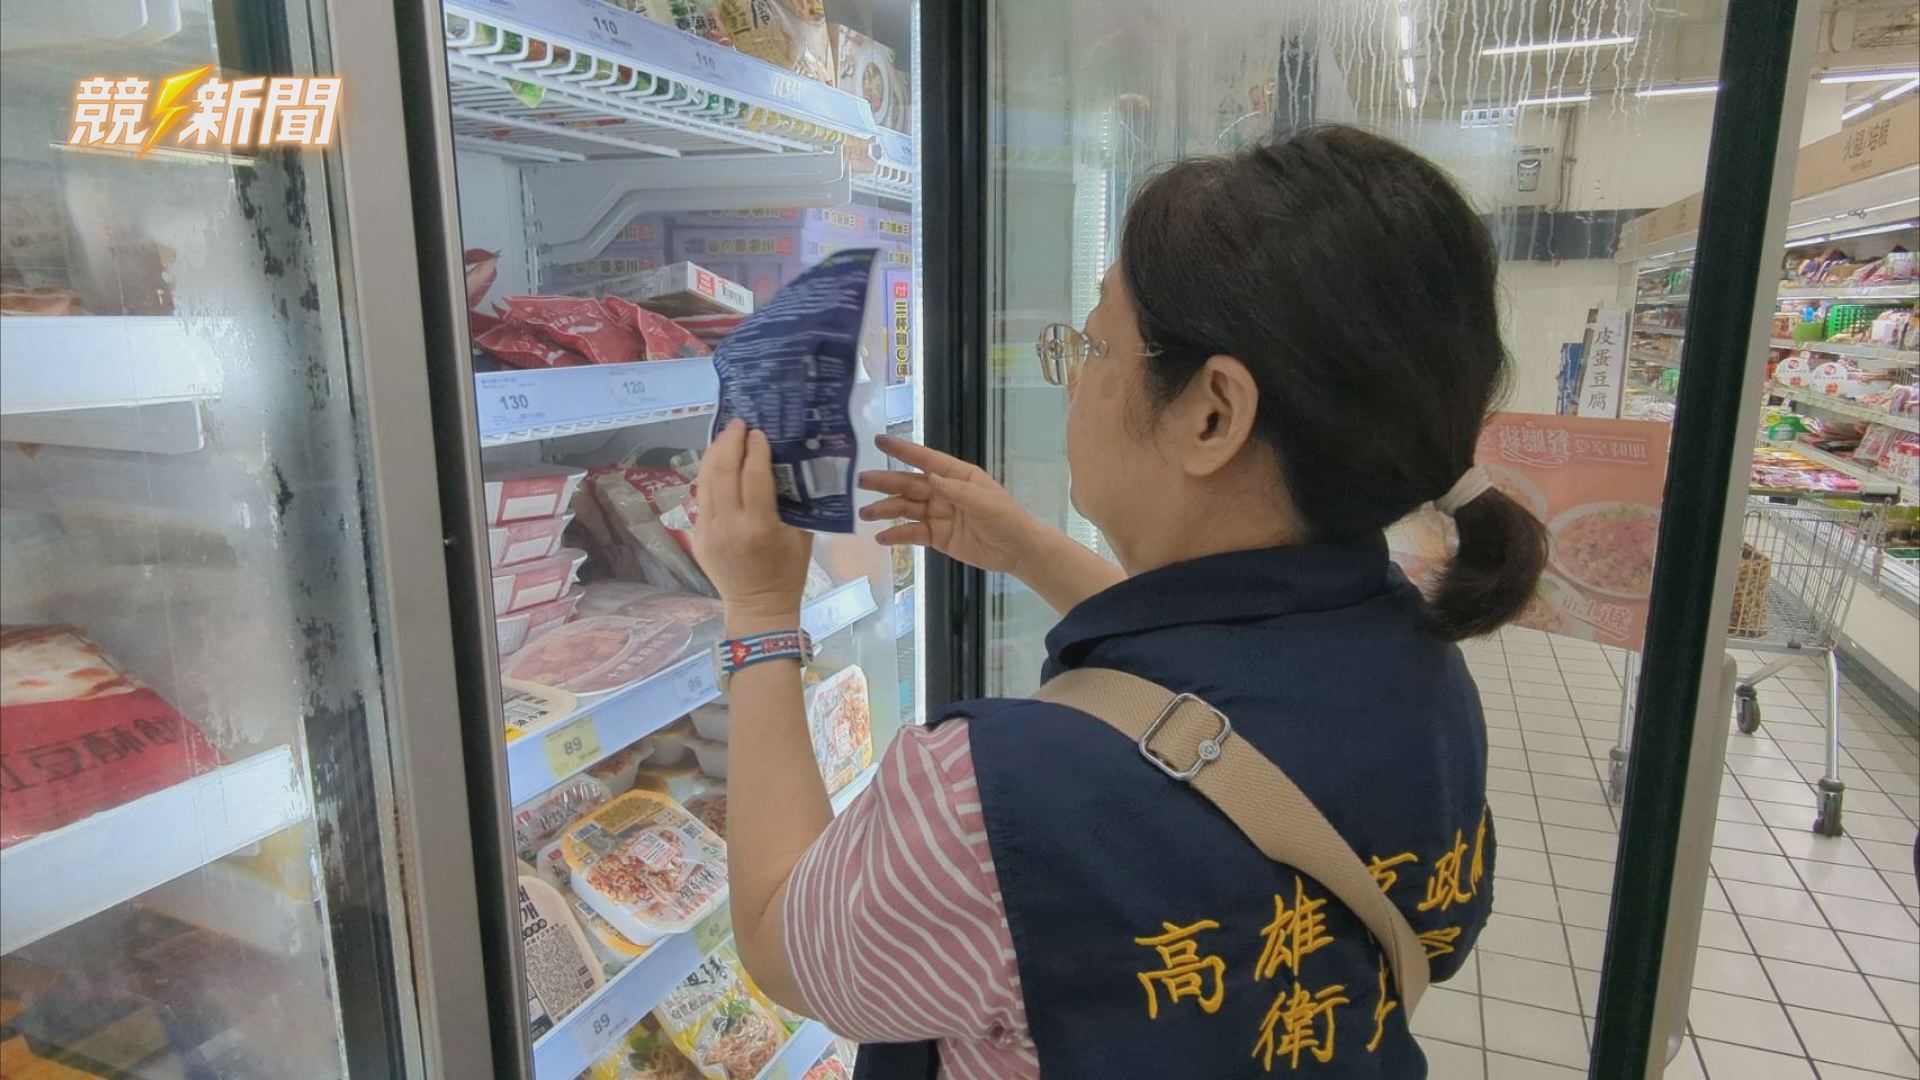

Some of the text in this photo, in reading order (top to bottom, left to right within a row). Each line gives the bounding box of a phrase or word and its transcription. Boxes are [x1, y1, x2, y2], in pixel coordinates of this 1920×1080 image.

[592, 15, 618, 36] 110
[1586, 326, 1617, 412] 皮蛋豆腐
[622, 380, 646, 395] 120
[499, 393, 530, 411] 130
[563, 736, 583, 756] 89
[592, 1013, 611, 1035] 89
